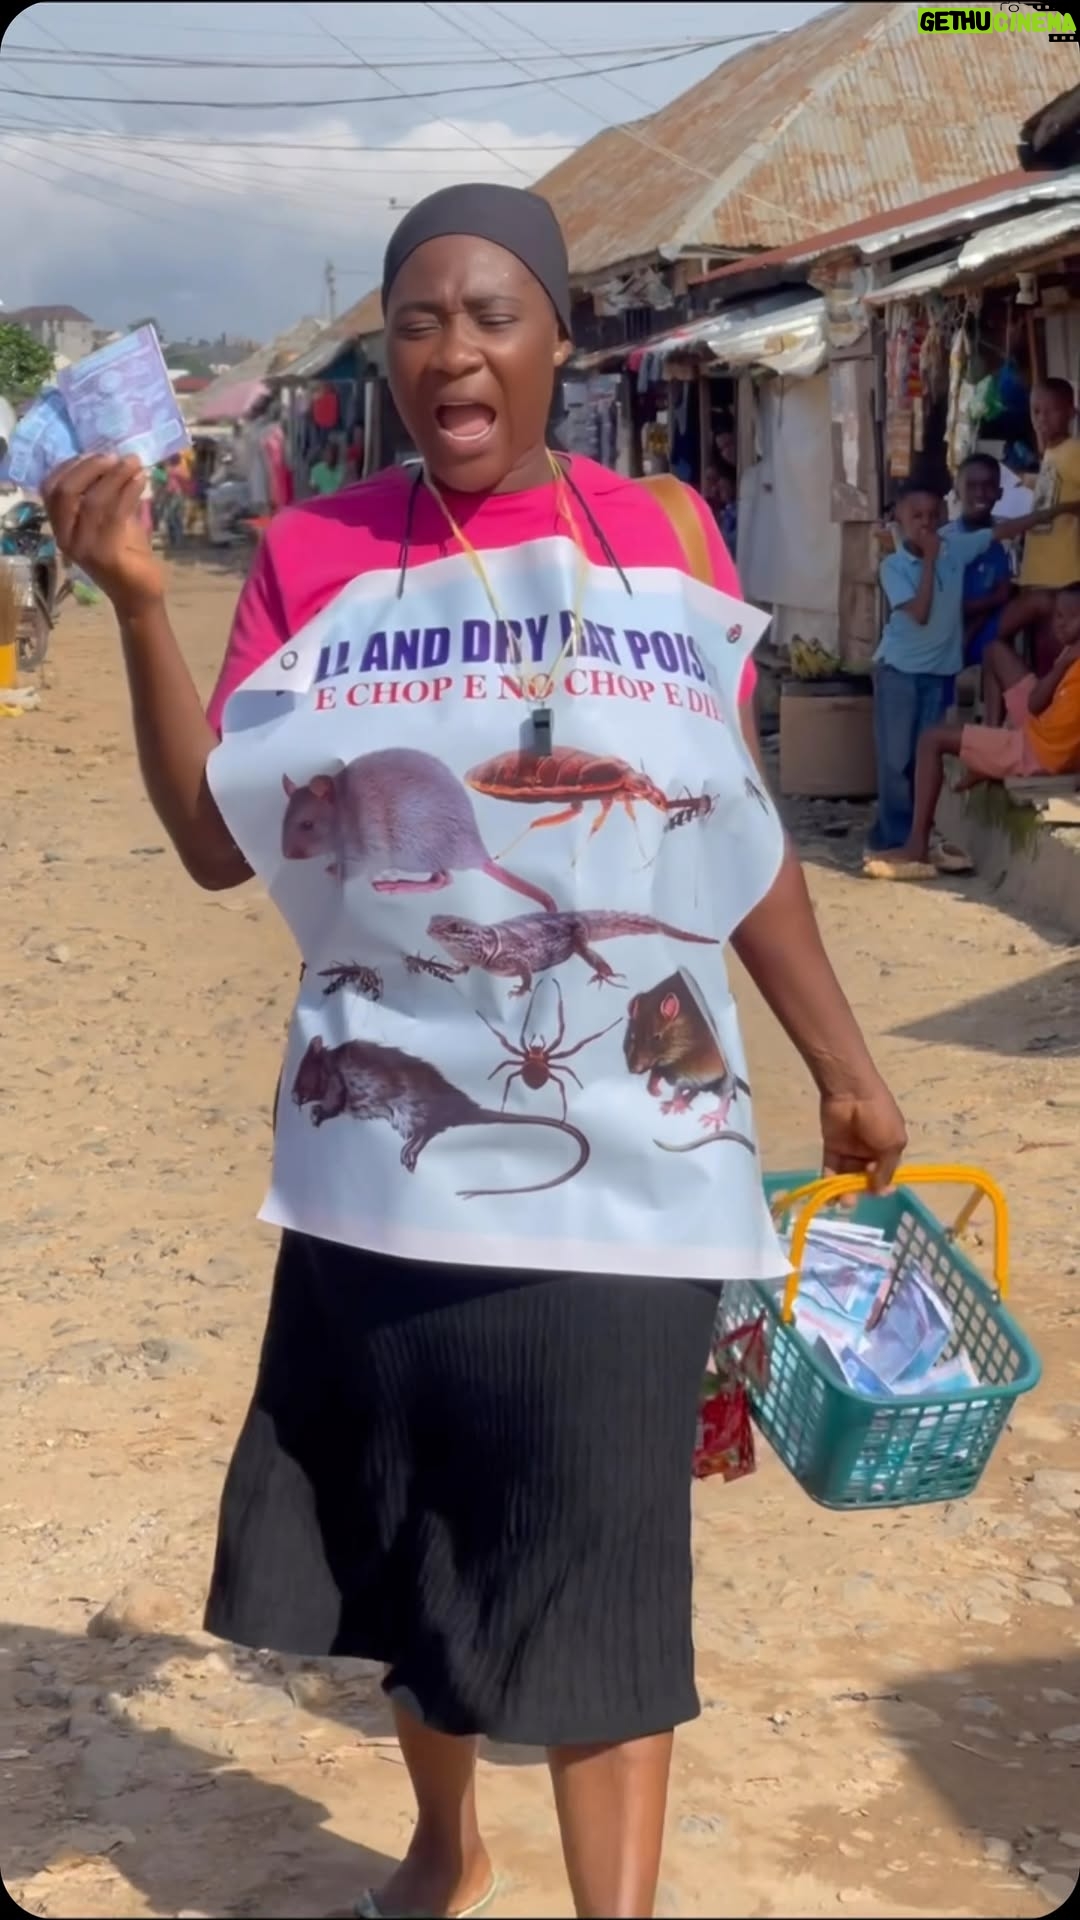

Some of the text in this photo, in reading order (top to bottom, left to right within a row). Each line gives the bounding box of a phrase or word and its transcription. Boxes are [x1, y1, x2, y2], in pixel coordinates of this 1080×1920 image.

[359, 626, 451, 673] AND
[462, 614, 549, 664] DRY
[623, 629, 715, 686] POIS
[315, 685, 337, 711] E
[346, 676, 453, 707] CHOP
[464, 674, 487, 700] E
[498, 673, 555, 700] NO
[564, 668, 655, 703] CHOP
[662, 681, 684, 707] E
